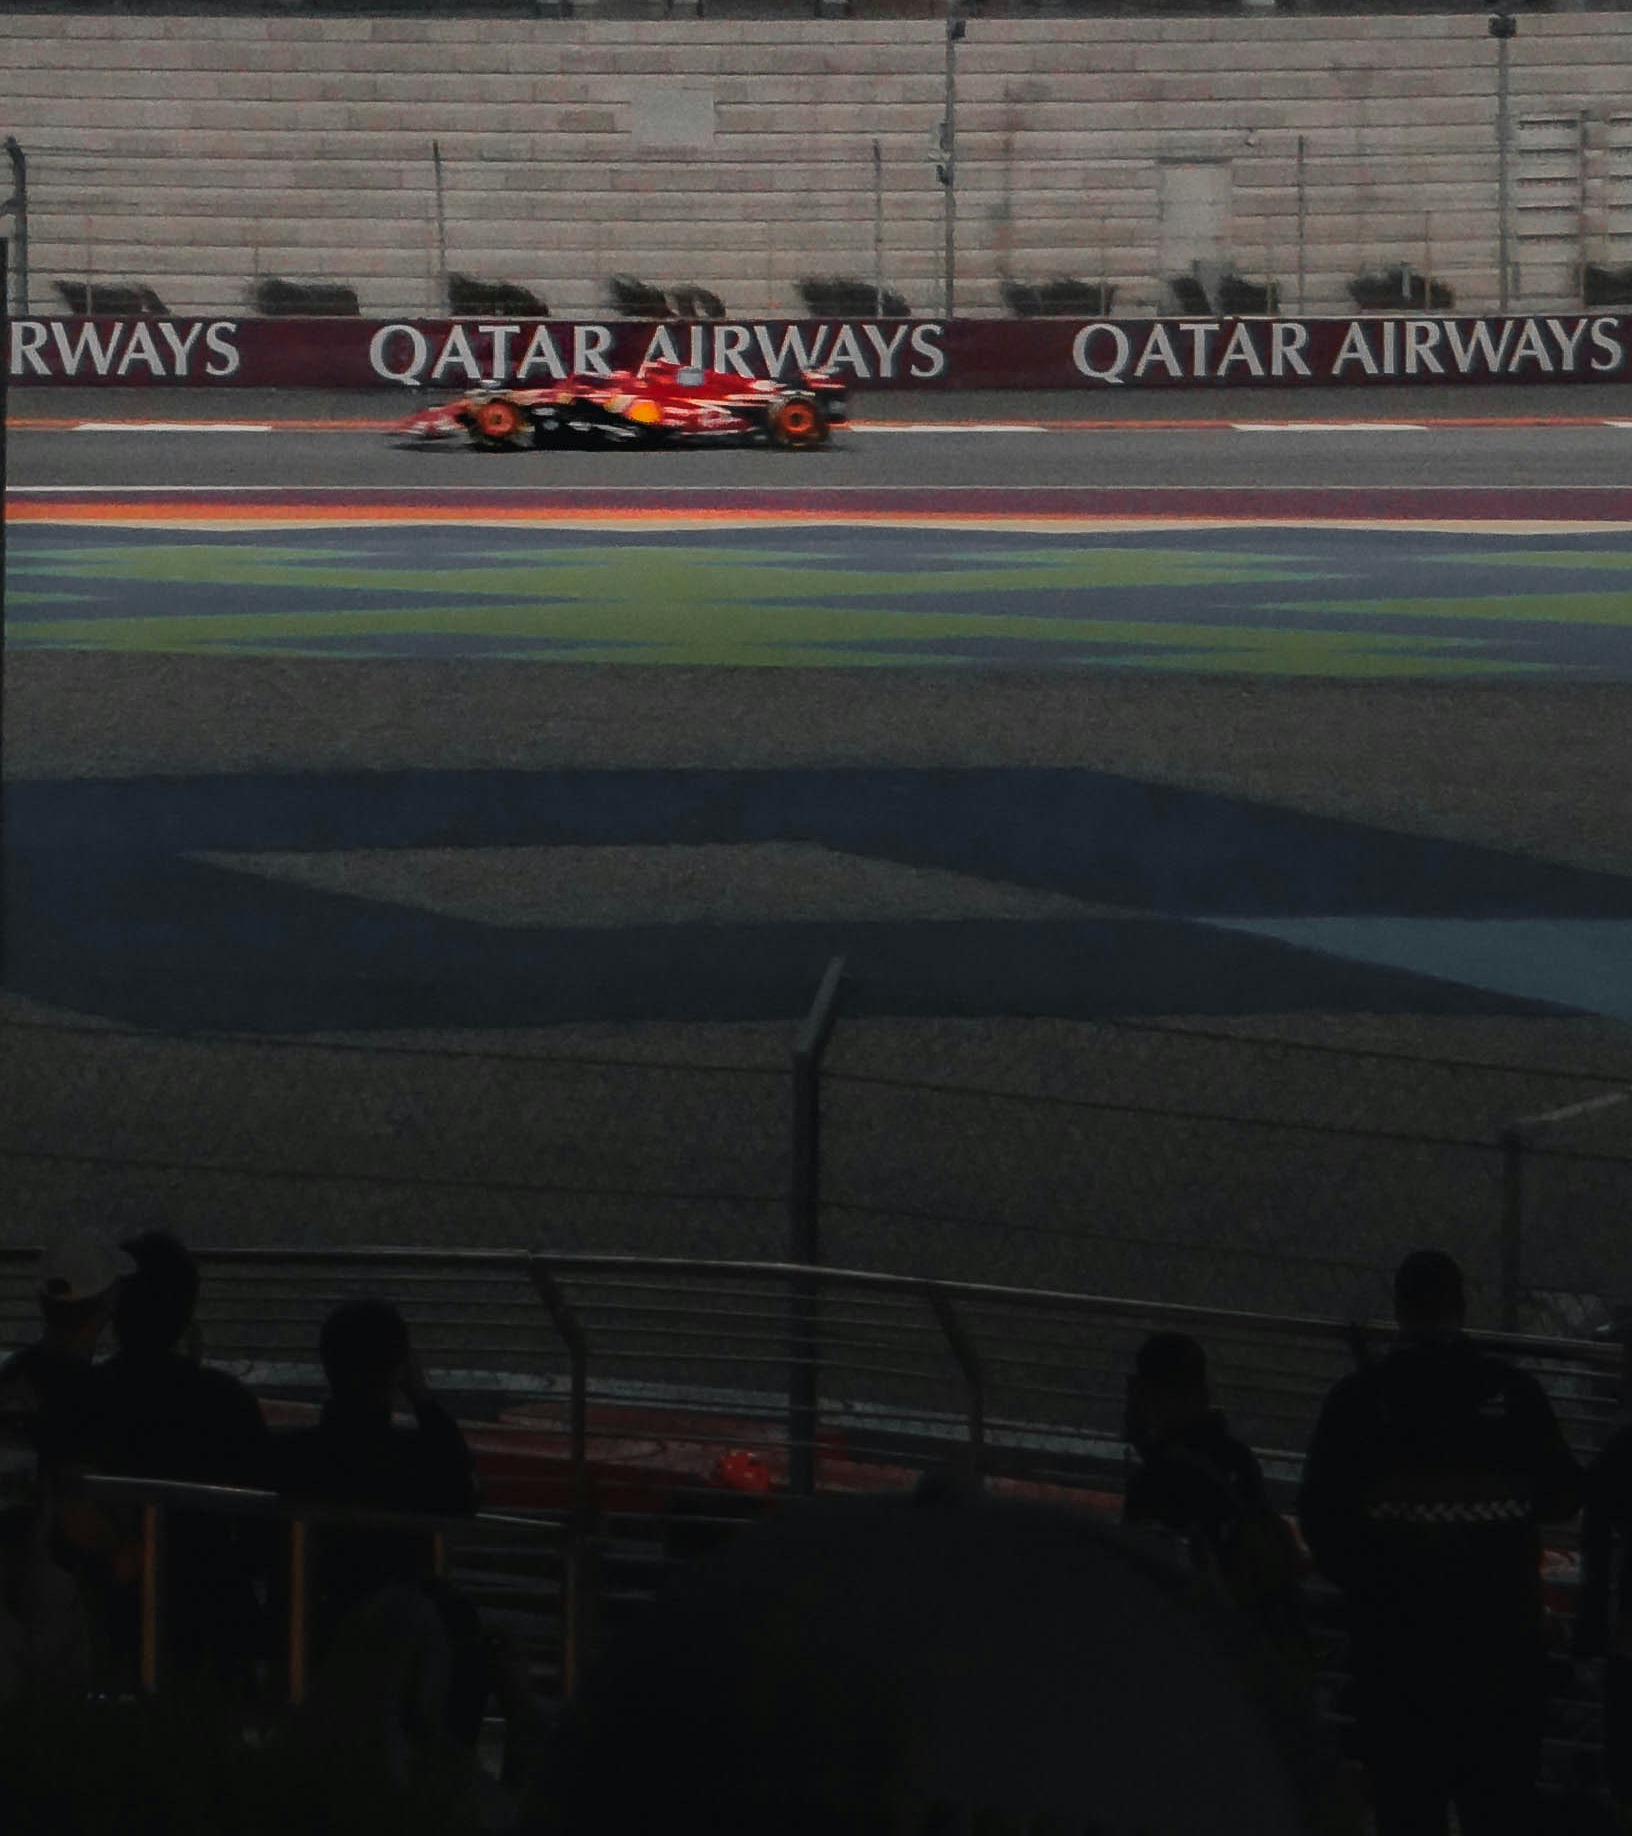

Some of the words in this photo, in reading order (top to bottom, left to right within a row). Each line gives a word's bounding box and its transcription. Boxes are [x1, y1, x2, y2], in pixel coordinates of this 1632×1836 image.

[11, 321, 240, 376] RWAYS
[369, 324, 612, 385] QATAR
[640, 323, 945, 379] AIRWAYS
[1072, 322, 1311, 383] QATAR
[1331, 318, 1622, 374] AIRWAYS
